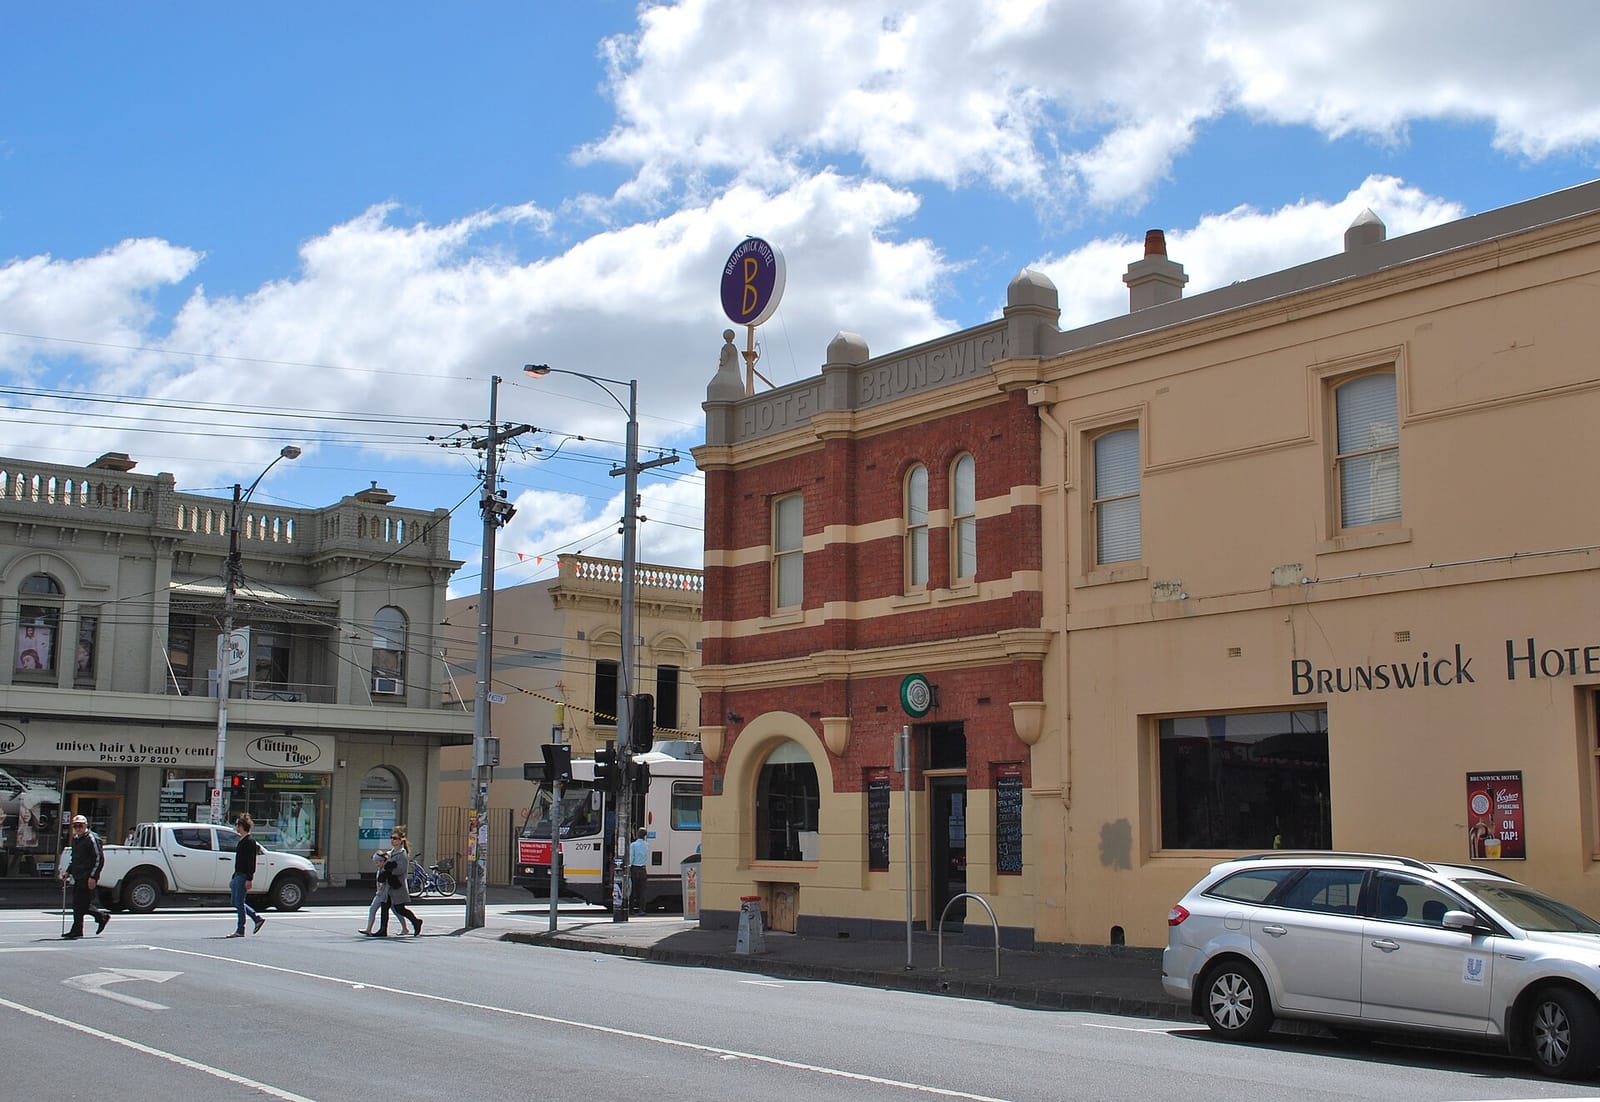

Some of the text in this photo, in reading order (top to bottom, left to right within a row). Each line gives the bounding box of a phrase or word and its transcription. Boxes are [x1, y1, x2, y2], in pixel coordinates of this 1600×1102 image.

[725, 241, 774, 275] BRUNSWICK HOTEL
[742, 257, 758, 315] B
[56, 741, 96, 752] unisex
[99, 742, 125, 753] hair
[140, 744, 181, 757] beauty
[185, 746, 216, 757] centr
[257, 739, 298, 754] Cutting
[100, 754, 117, 762] Ph:
[119, 755, 146, 763] 9387
[286, 753, 312, 764] Edge
[1503, 820, 1514, 829] ON
[1500, 832, 1518, 840] TAP!
[576, 843, 591, 851] 2097
